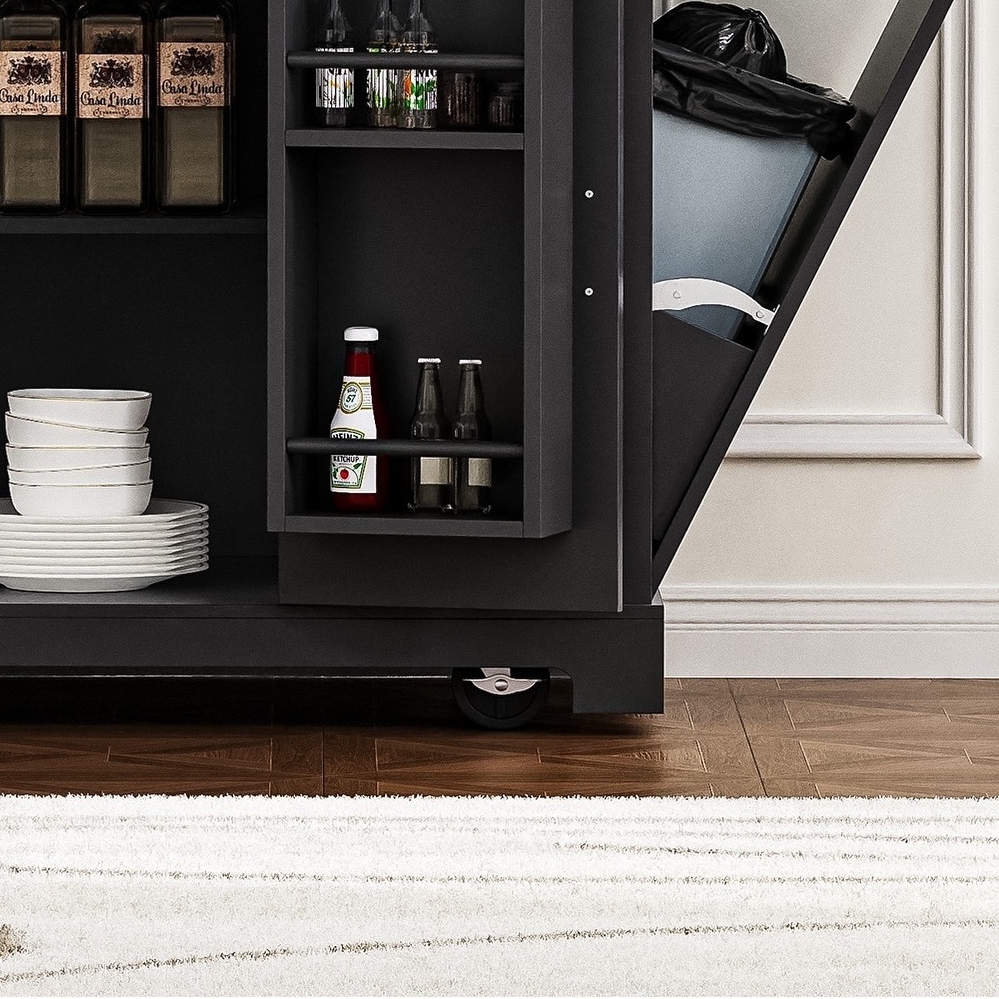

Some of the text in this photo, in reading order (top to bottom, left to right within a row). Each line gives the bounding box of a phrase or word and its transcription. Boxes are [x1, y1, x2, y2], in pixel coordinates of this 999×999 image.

[162, 80, 222, 96] Casa Linda
[25, 89, 59, 104] Linda
[80, 91, 141, 107] Casa Linda
[345, 394, 357, 403] 57
[333, 455, 360, 463] KETCHUP
